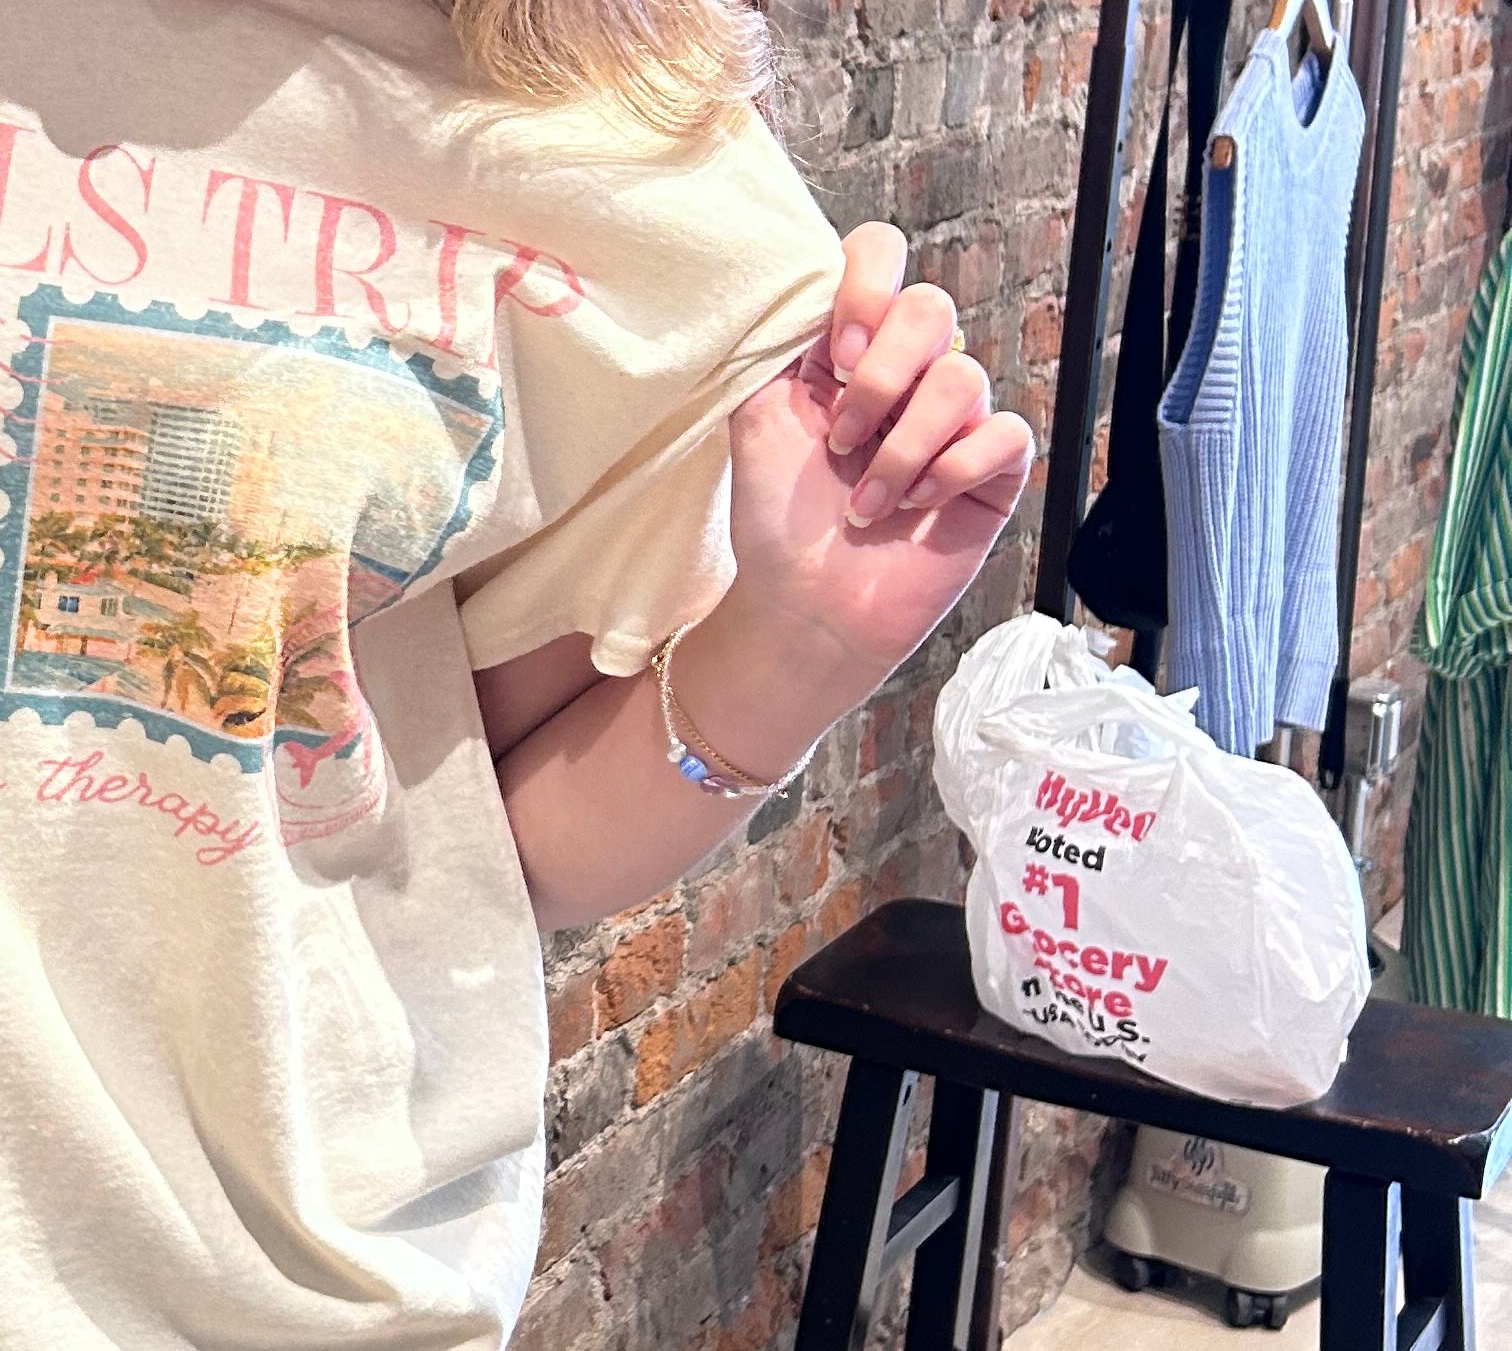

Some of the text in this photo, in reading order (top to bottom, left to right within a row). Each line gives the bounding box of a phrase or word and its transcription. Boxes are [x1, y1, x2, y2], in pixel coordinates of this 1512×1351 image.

[201, 168, 586, 370] TRIP
[35, 751, 264, 866] therapy
[1000, 901, 1169, 994] Gocery
[1021, 861, 1080, 930] #1
